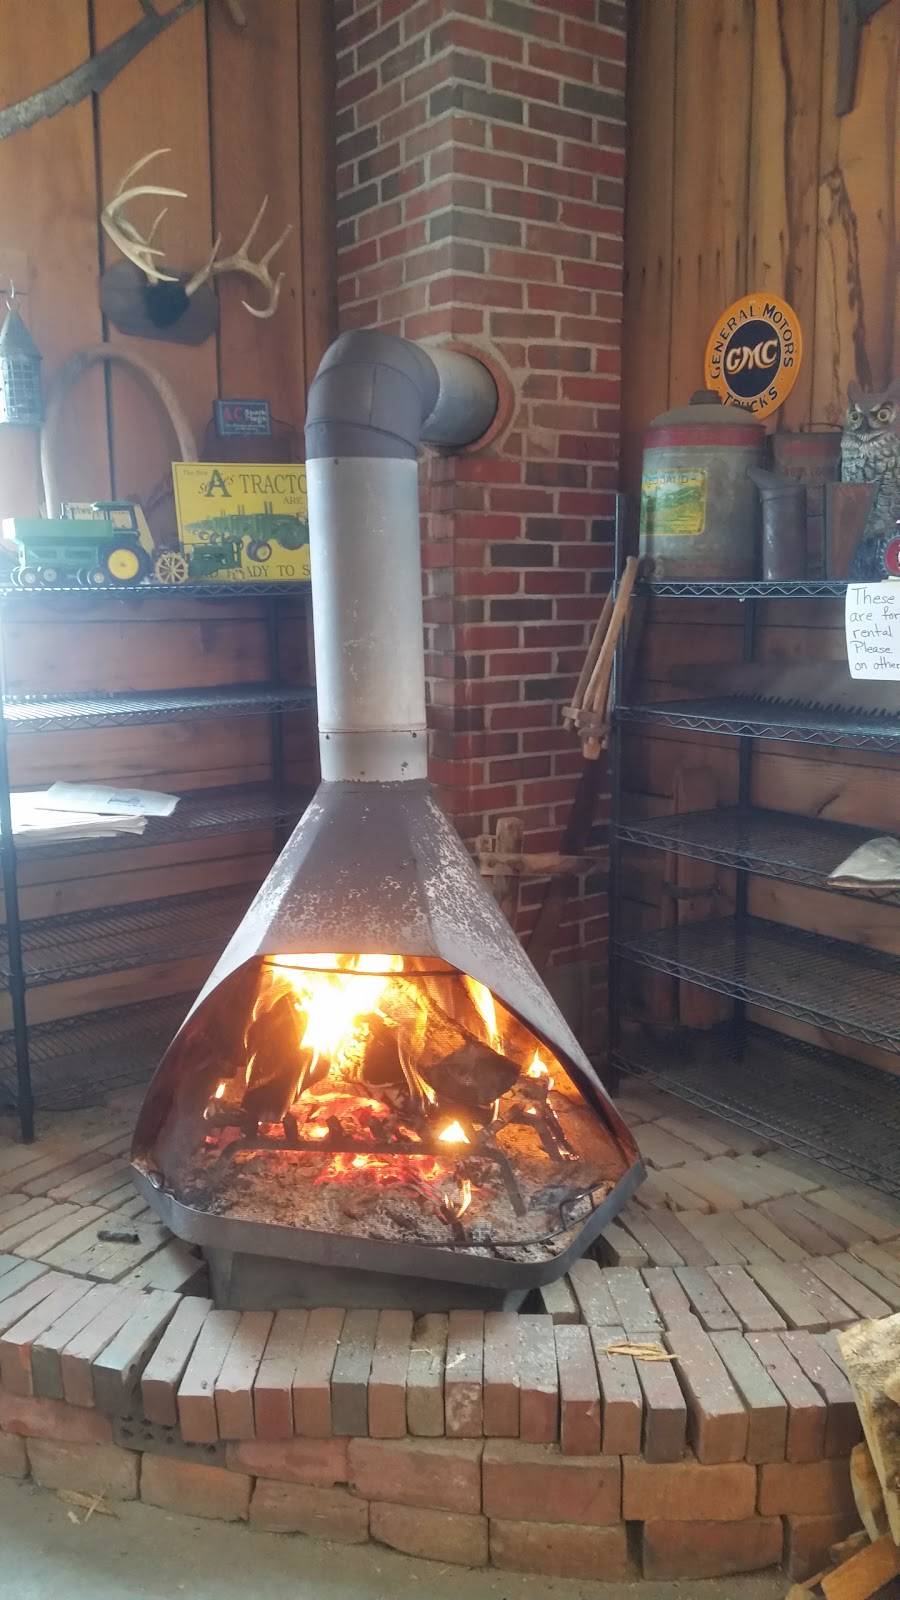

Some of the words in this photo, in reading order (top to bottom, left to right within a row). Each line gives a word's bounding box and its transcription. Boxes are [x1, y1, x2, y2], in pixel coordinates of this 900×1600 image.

[711, 305, 755, 379] GENERAL
[763, 303, 794, 368] MOTORS
[726, 338, 778, 375] GMC
[276, 565, 295, 577] TO
[851, 587, 895, 605] These
[850, 612, 872, 622] are
[881, 606, 900, 620] for
[853, 624, 892, 639] rental
[850, 641, 893, 654] Please
[855, 662, 867, 671] on
